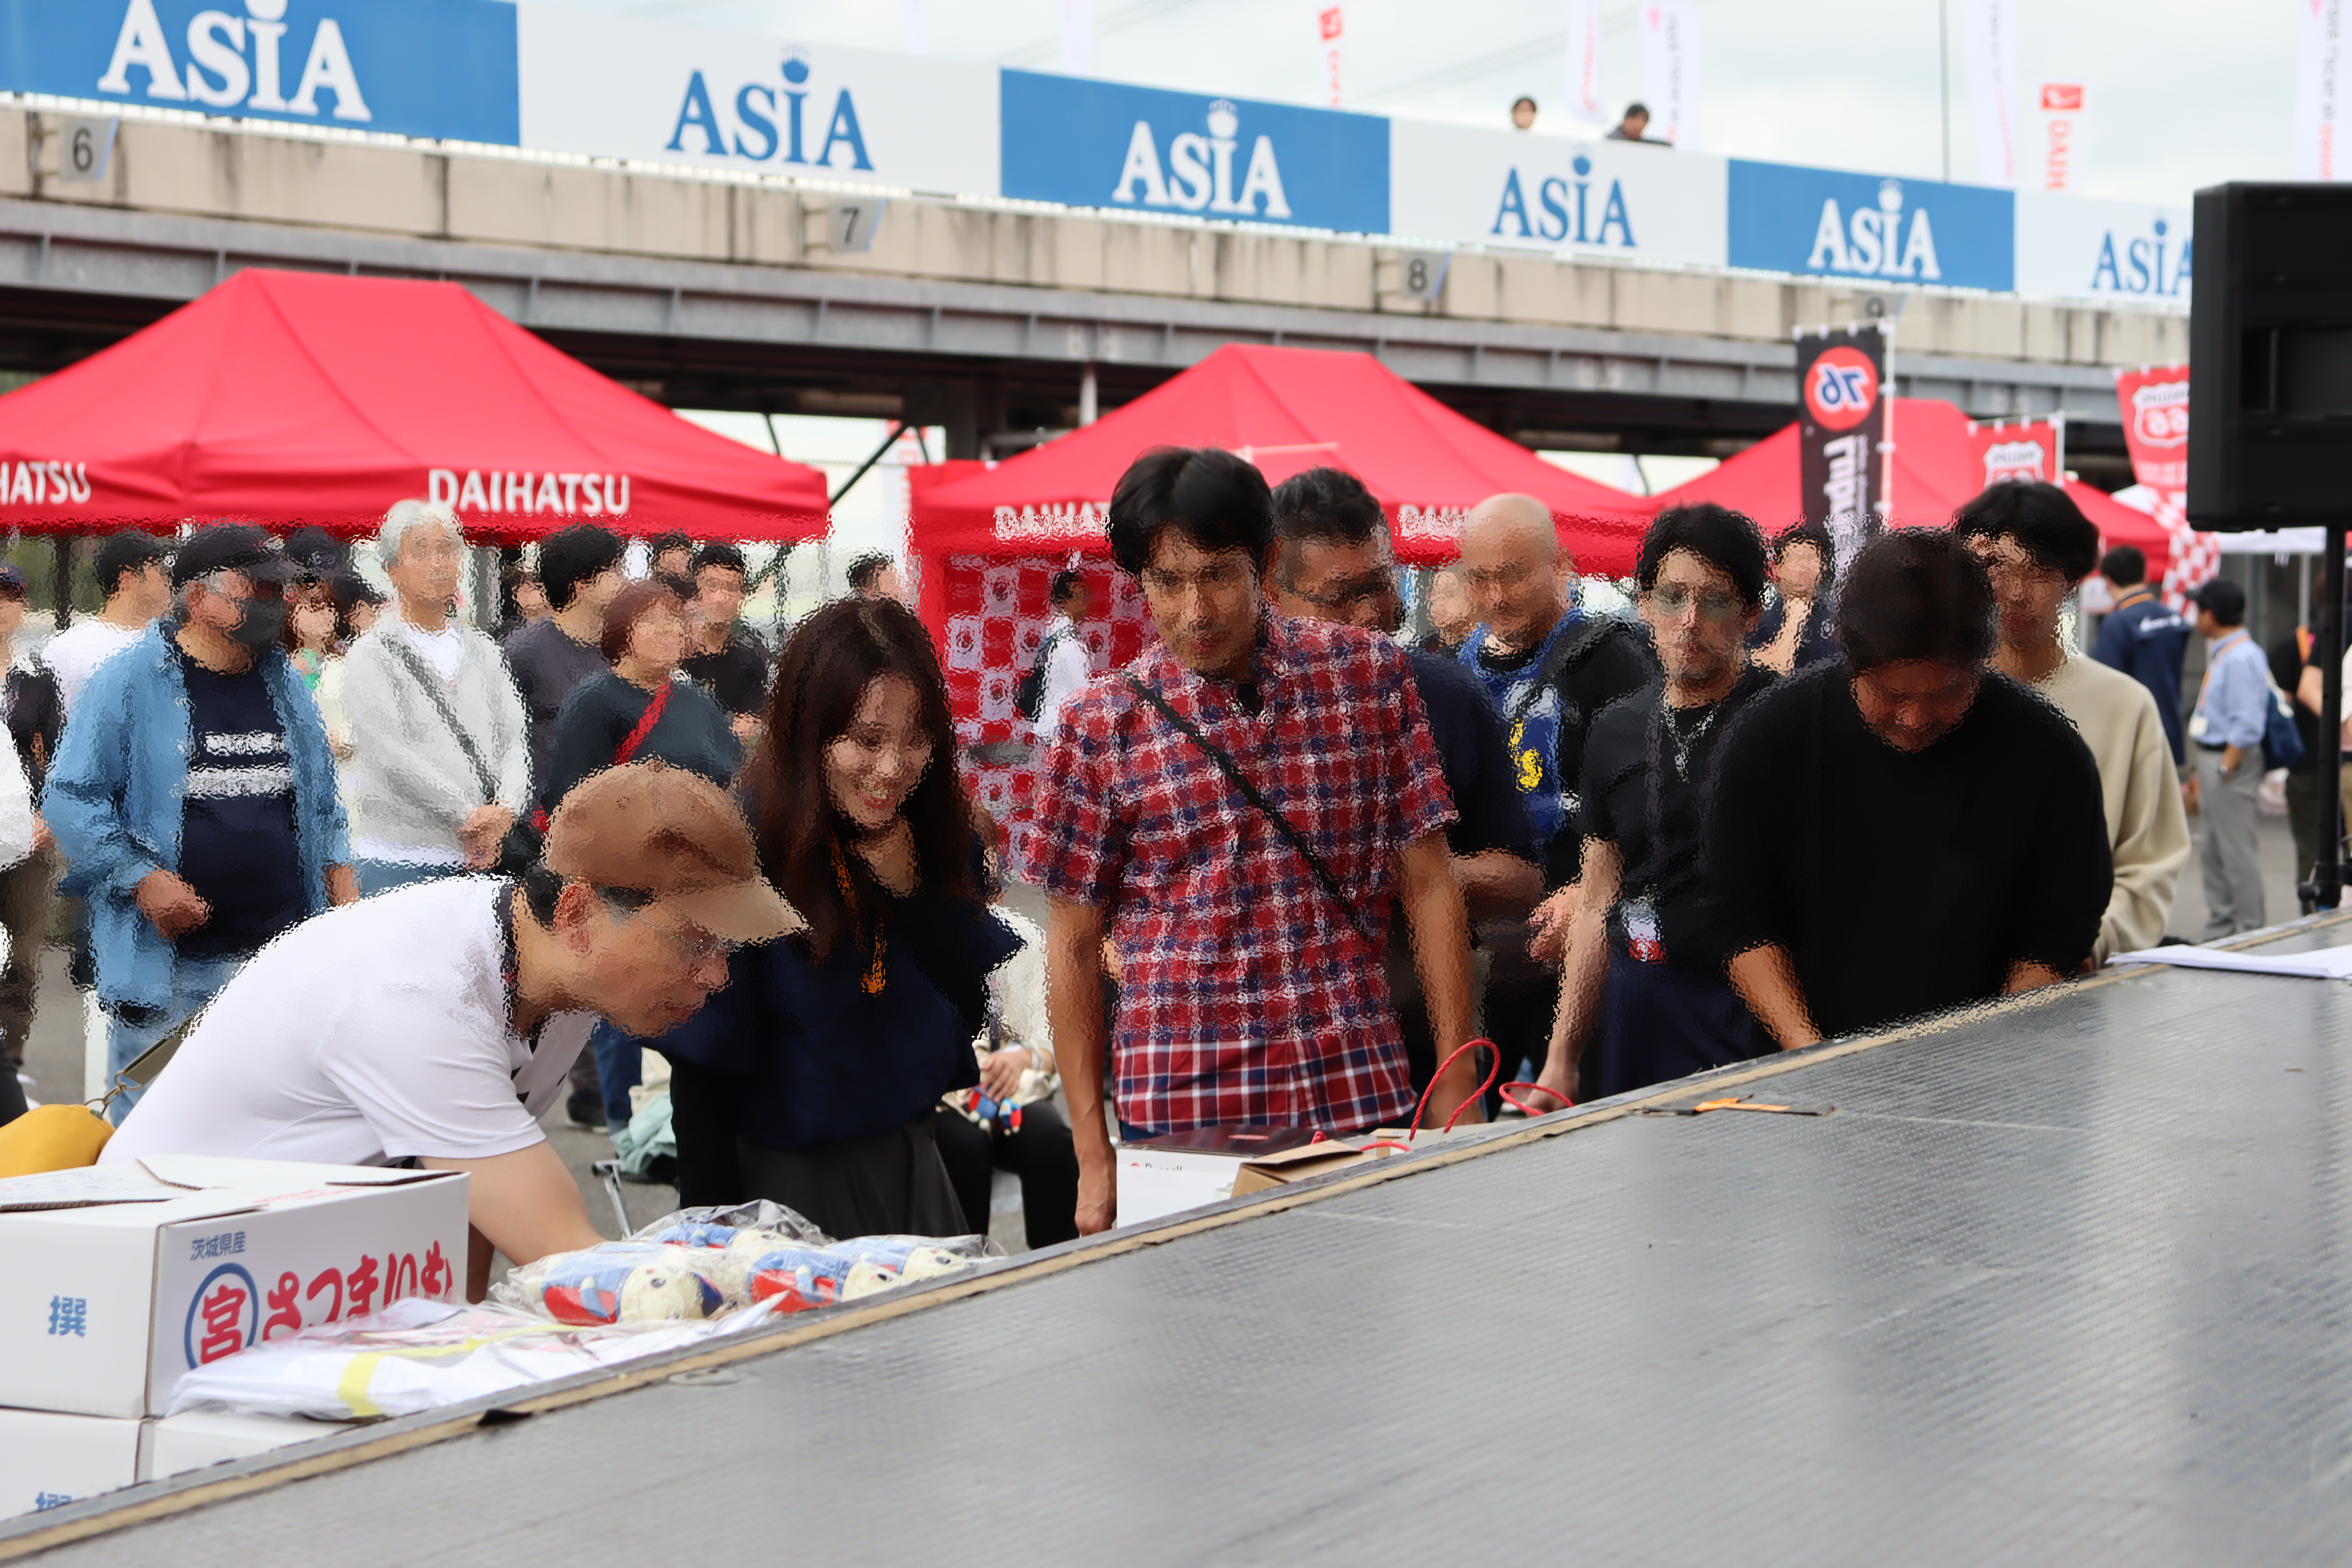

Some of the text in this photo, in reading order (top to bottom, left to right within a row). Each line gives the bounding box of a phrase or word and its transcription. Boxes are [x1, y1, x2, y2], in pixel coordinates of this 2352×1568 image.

[97, 0, 372, 122] ASIA
[665, 68, 876, 172] ASIA
[72, 128, 93, 172] 6
[1111, 120, 1292, 219] ASIA
[840, 207, 859, 245] 7
[1490, 166, 1637, 248] ASIA
[1807, 198, 1941, 280] ASIA
[1409, 258, 1428, 292] 8
[428, 468, 630, 514] DAIHATSU
[191, 1231, 246, 1260] 茨城県産
[48, 1295, 87, 1337] 撰
